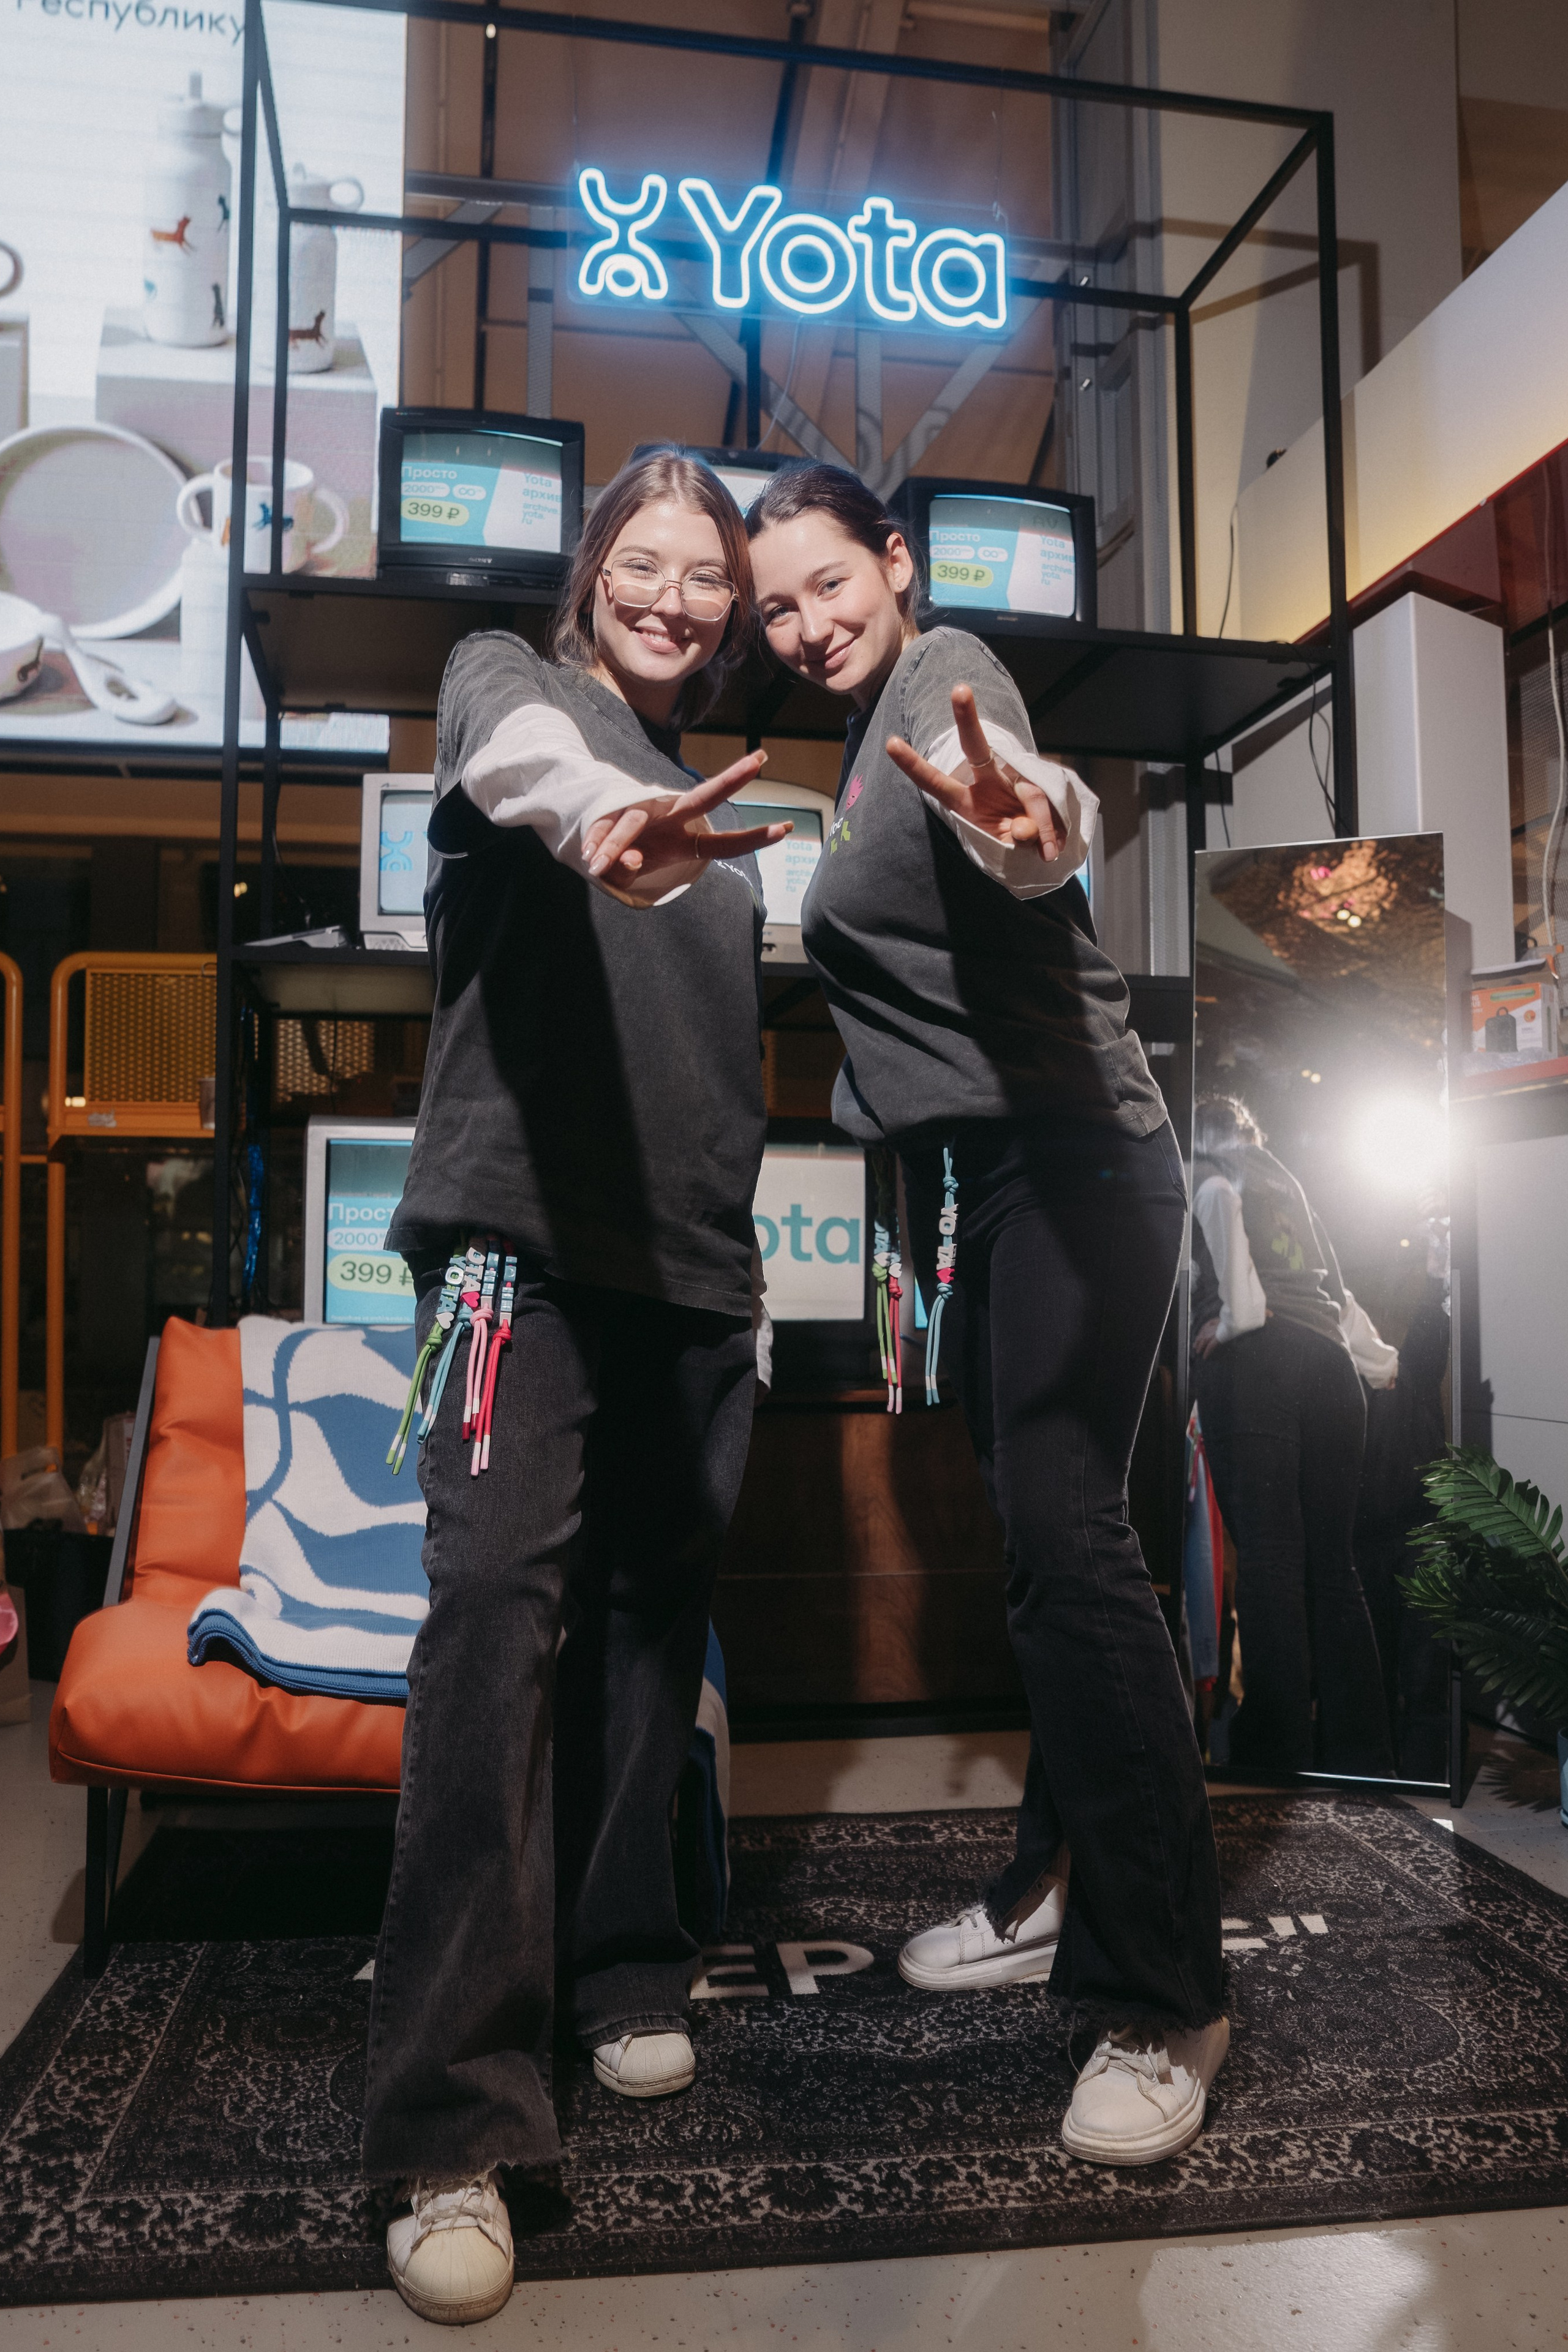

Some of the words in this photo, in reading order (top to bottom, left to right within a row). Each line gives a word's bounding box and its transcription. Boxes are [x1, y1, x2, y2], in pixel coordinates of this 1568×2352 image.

[677, 178, 1007, 329] Yota
[402, 466, 458, 480] Просто
[524, 472, 552, 487] Yota
[408, 502, 442, 518] 399
[929, 530, 981, 543] Просто
[1040, 534, 1065, 548] Yota
[937, 565, 969, 581] 399
[785, 840, 812, 851] Yota
[334, 1232, 378, 1245] 2000
[752, 1204, 860, 1264] ota
[341, 1260, 391, 1284] 399
